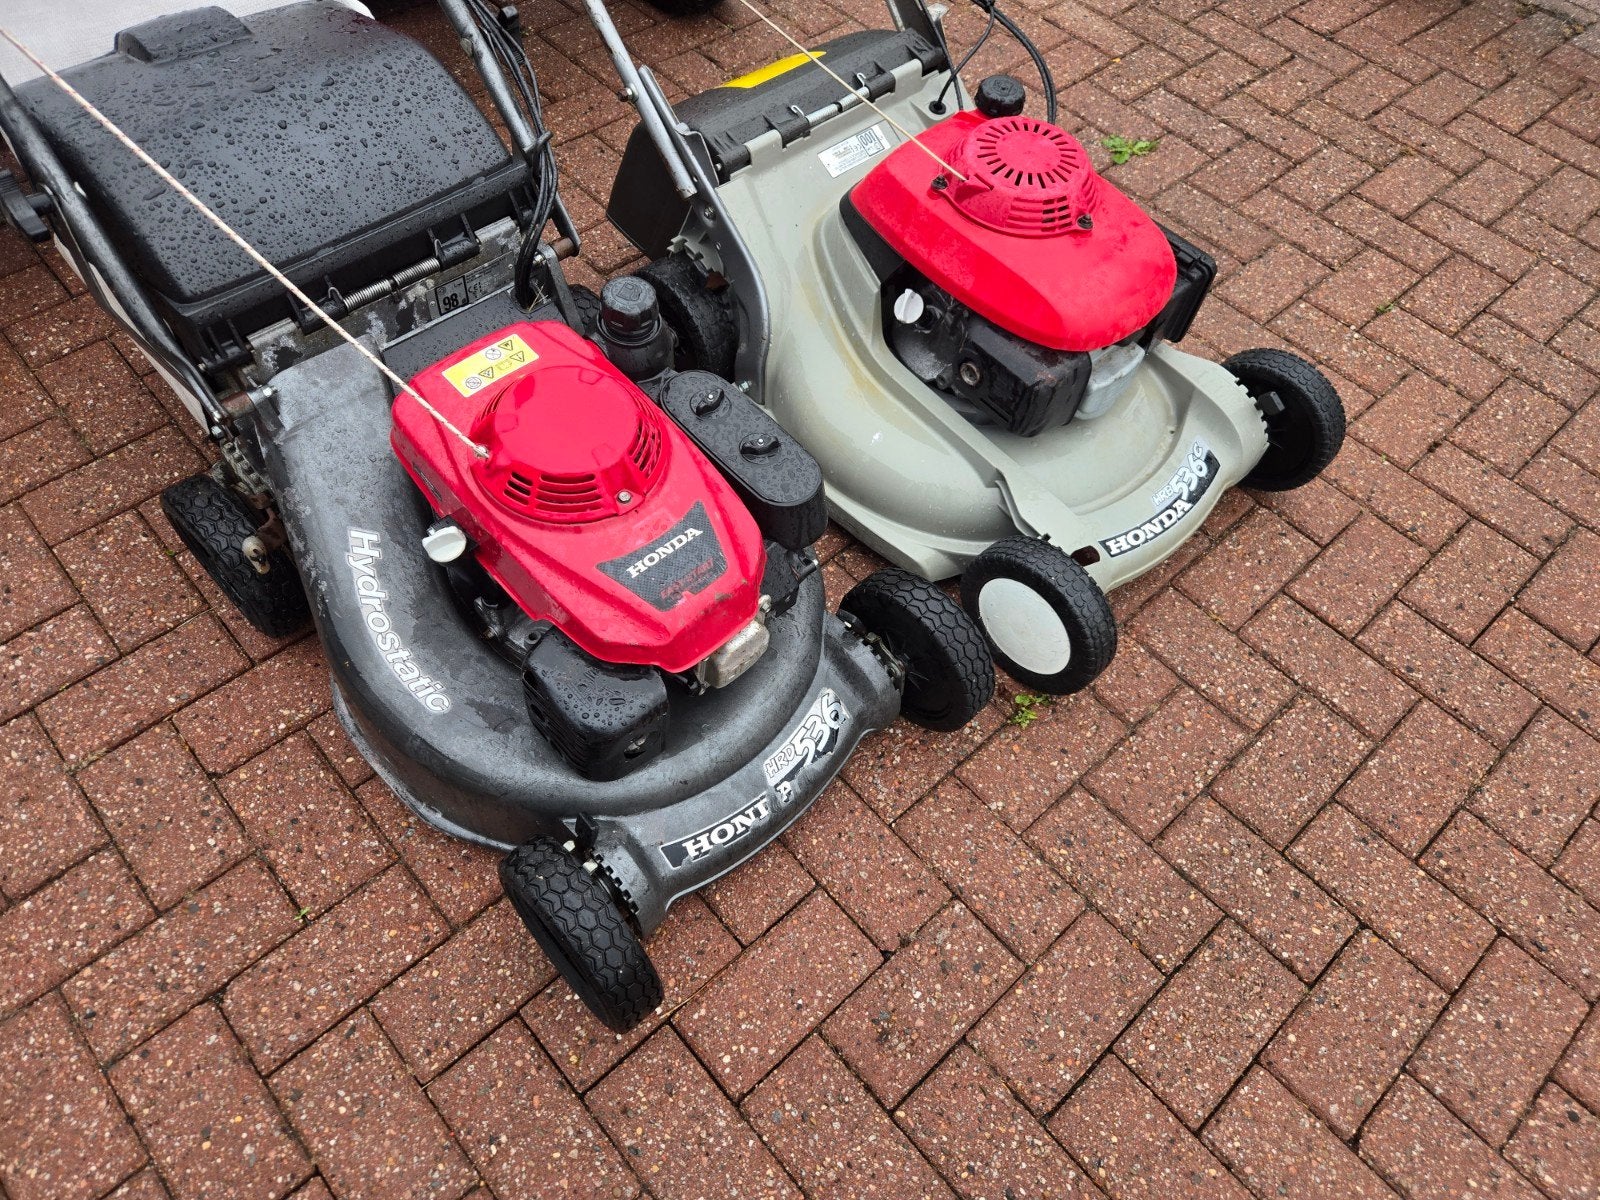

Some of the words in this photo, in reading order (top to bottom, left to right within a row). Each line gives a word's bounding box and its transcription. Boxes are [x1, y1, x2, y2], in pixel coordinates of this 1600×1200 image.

[442, 292, 459, 311] 98
[625, 527, 703, 579] HONDA
[1105, 499, 1194, 556] HONDA
[347, 527, 450, 713] Hydrostatic
